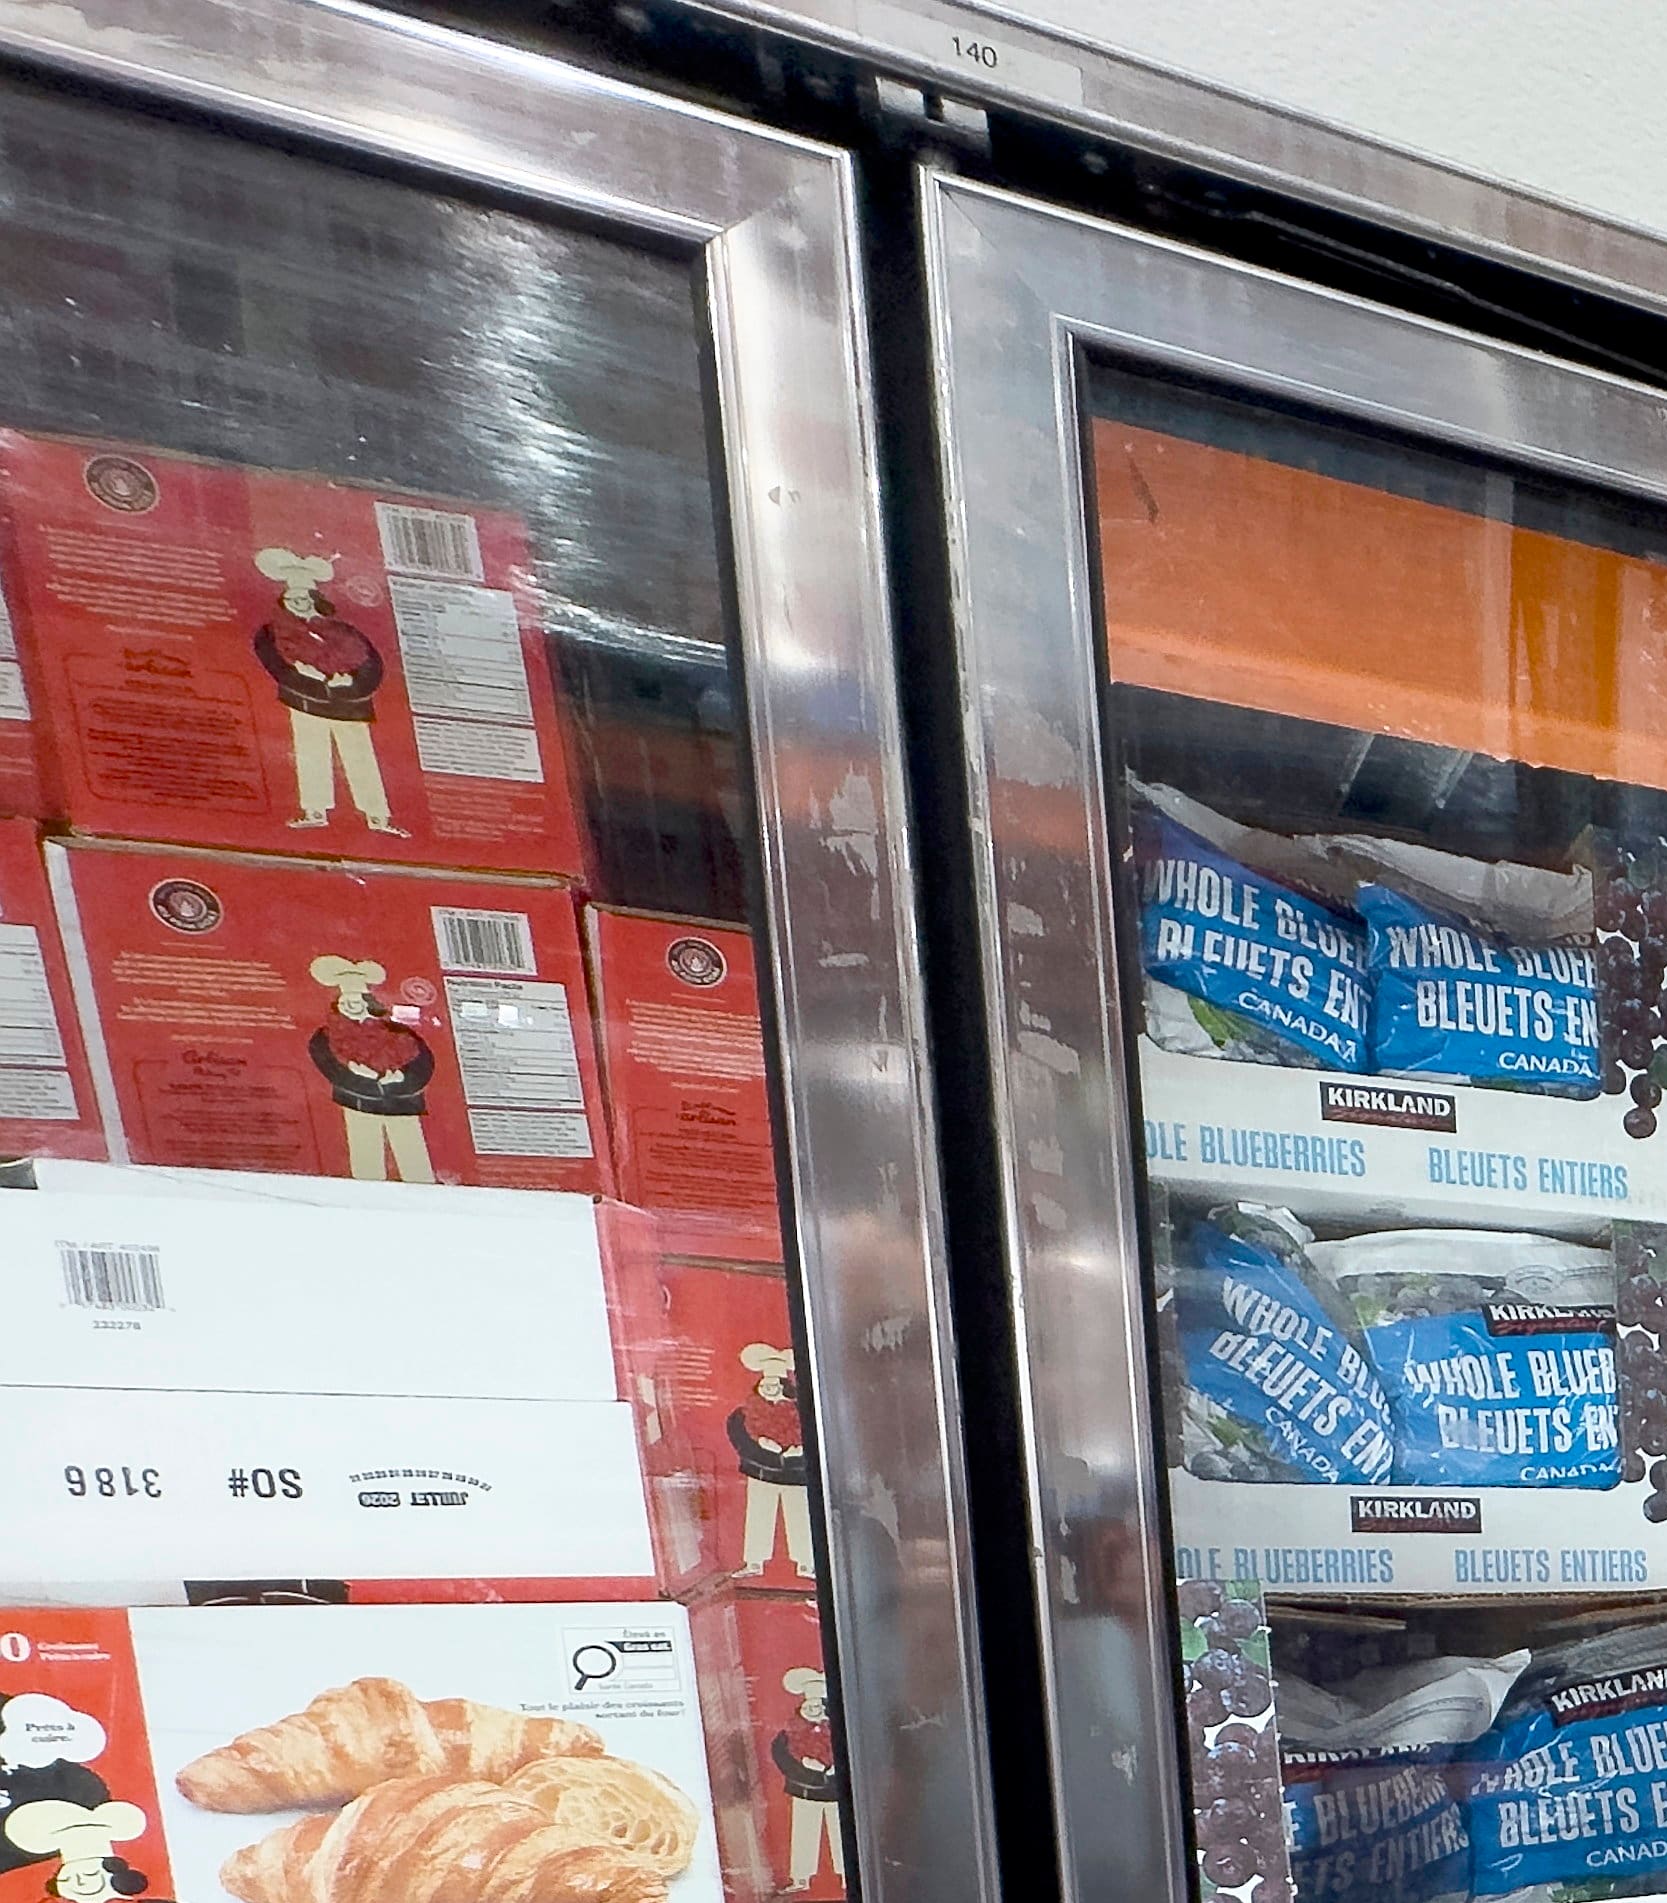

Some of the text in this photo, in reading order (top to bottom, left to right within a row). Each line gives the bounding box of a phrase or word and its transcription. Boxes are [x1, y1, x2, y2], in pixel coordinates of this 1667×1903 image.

[952, 36, 998, 68] 140
[1417, 981, 1554, 1044] BLEUETS
[1500, 1052, 1592, 1075] CANADA
[1327, 1086, 1450, 1117] KIRKLAND
[1200, 1126, 1629, 1200] BLUEBERRIES BLEUETS ENTIERS
[64, 1465, 302, 1498] SO# 3186
[1357, 1500, 1477, 1519] KIRKLAND
[1234, 1548, 1647, 1584] BLUEBERRIES BLEUETS ENTIERS
[1500, 1786, 1641, 1849] BLEUETS
